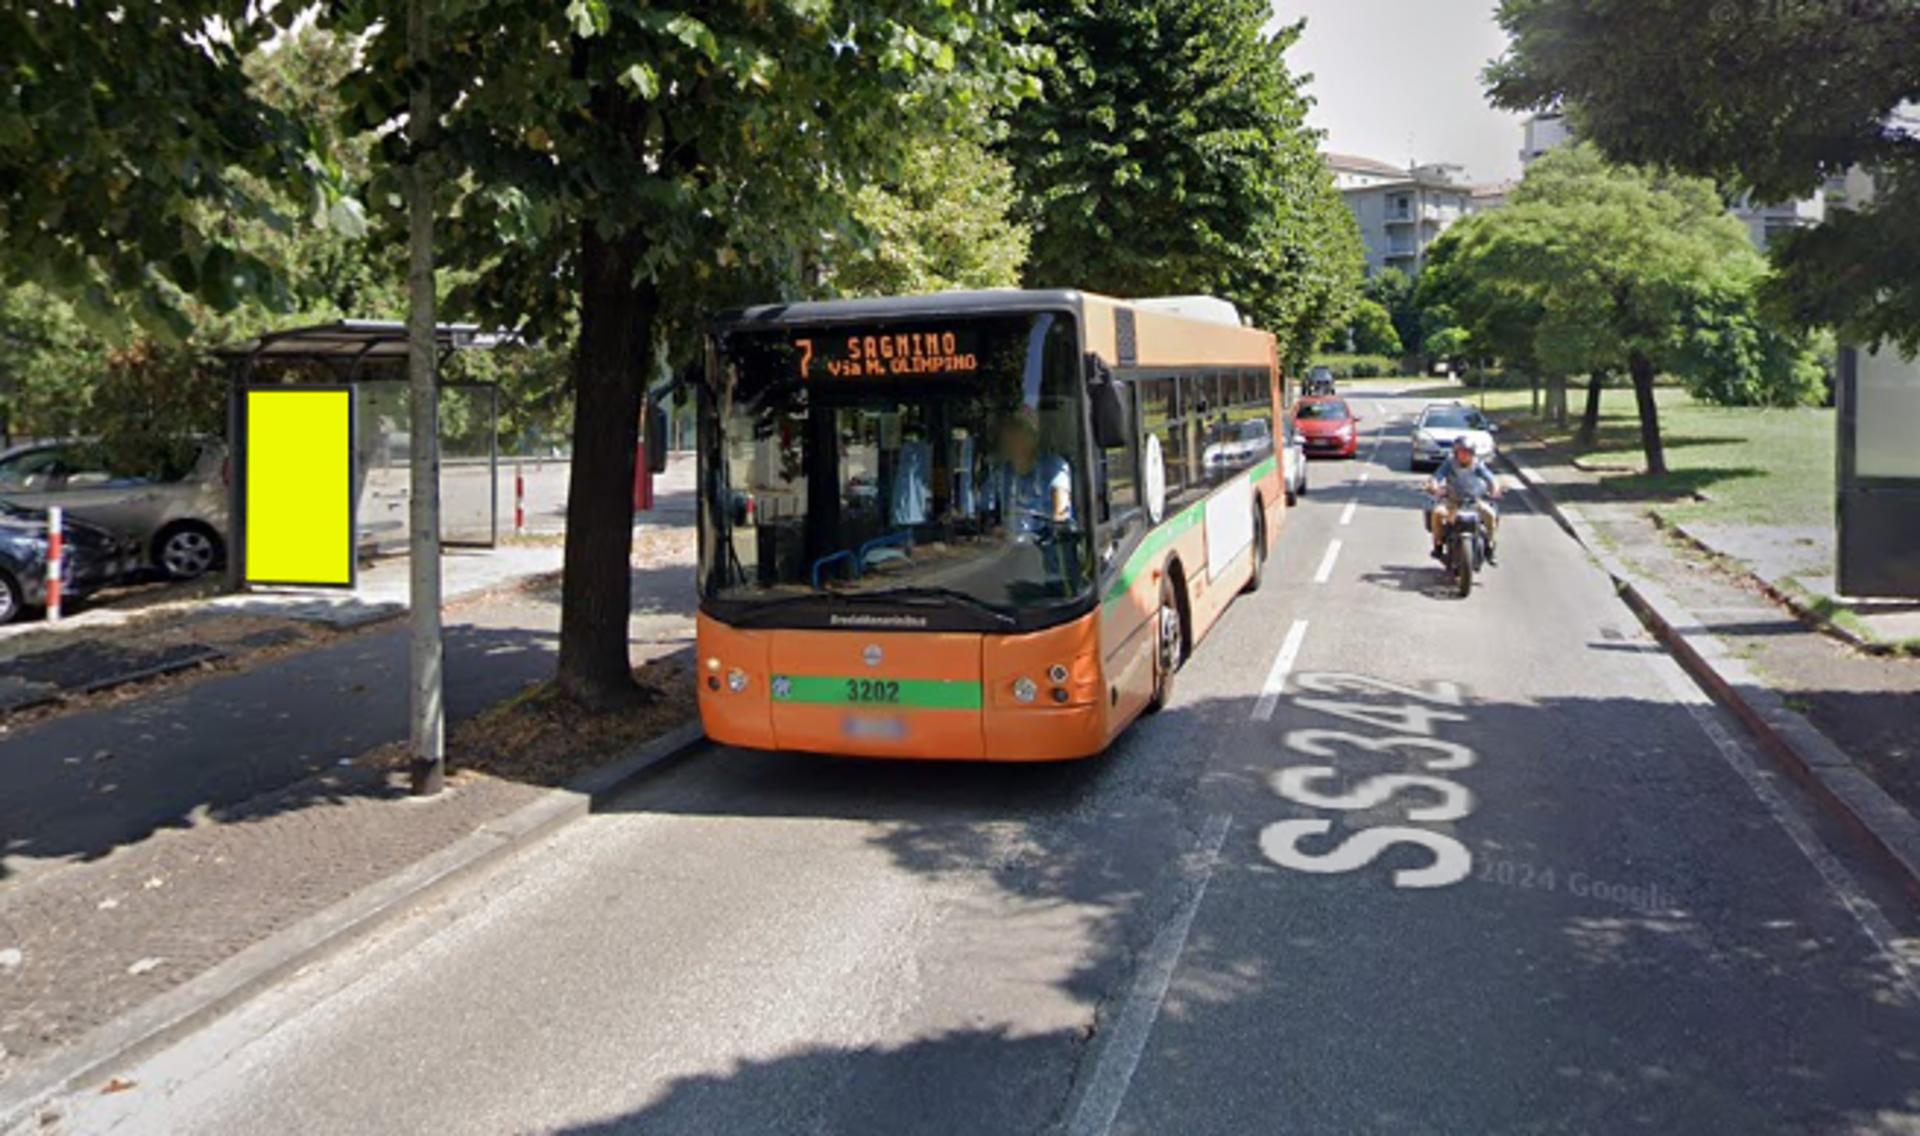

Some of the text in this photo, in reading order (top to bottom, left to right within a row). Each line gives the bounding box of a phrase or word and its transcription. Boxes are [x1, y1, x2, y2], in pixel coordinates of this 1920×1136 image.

[795, 339, 811, 378] 7
[846, 678, 899, 702] 3202
[1259, 671, 1476, 888] SS342
